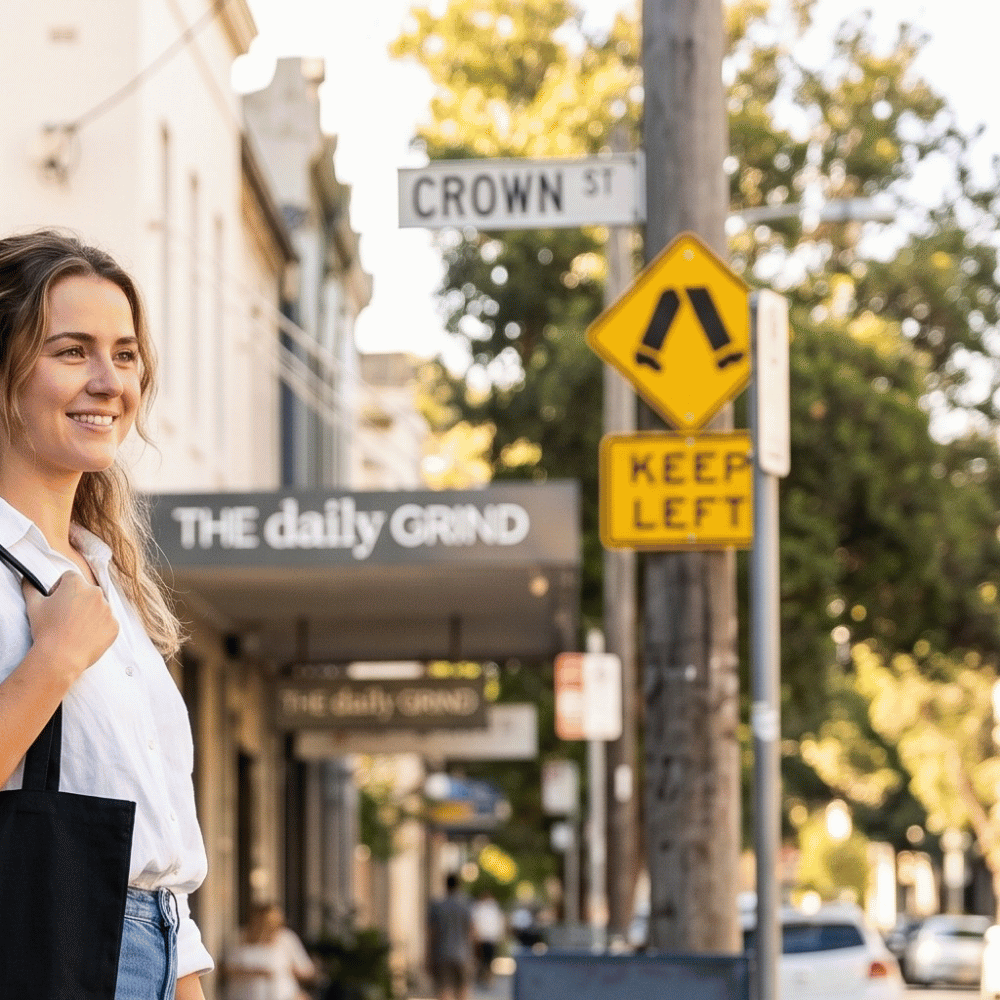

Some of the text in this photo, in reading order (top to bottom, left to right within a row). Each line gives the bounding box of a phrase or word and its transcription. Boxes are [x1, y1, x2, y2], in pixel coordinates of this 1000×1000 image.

[412, 167, 614, 218] CROWN ST
[629, 452, 753, 485] KEEP
[172, 498, 531, 560] THE daily GRIND
[633, 496, 747, 530] LEFT
